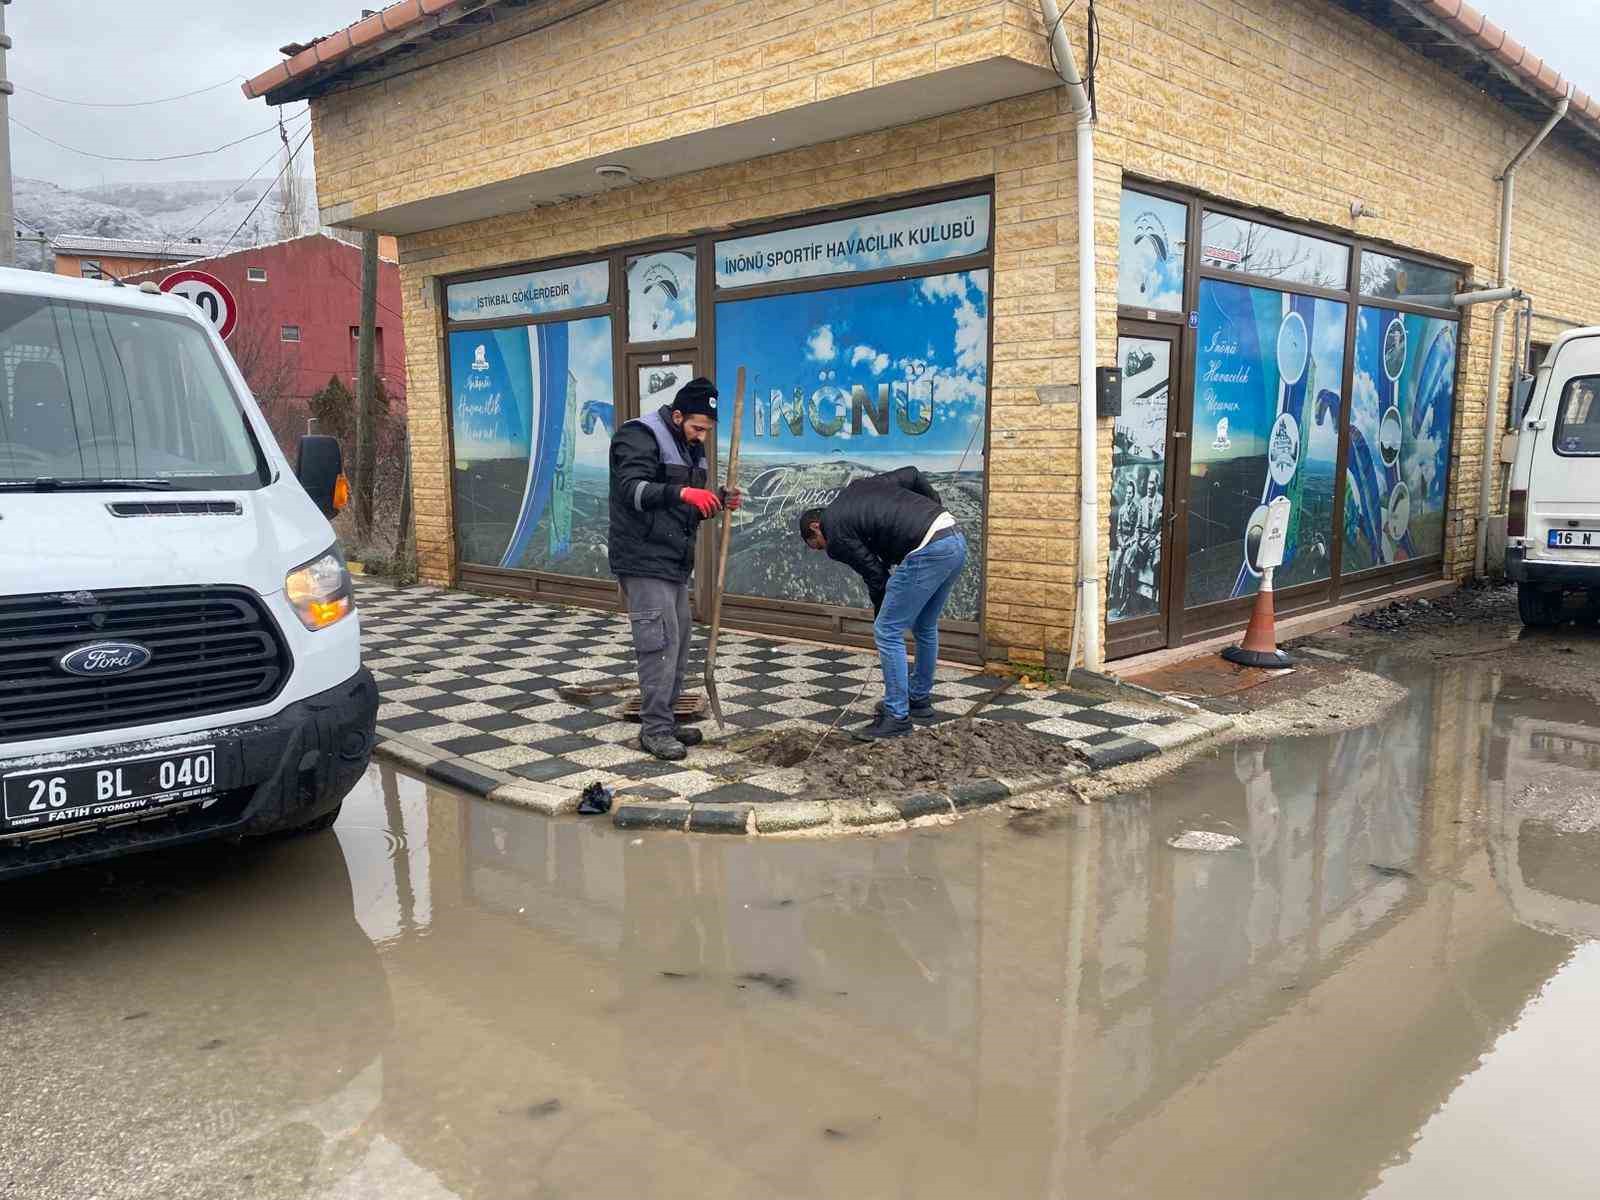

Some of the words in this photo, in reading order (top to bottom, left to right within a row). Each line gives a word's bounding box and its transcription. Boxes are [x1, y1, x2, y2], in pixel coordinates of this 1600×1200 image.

[725, 250, 764, 274] İNÖNÜ
[766, 242, 823, 267] SPORTİF
[826, 231, 904, 258] HAVACILIK
[908, 216, 975, 245] KULUBÜ
[173, 290, 219, 324] 0
[477, 293, 511, 309] İSTİKBAL
[753, 363, 935, 438] İNÖNÜ
[1557, 532, 1573, 545] 16
[83, 648, 133, 670] Ford
[28, 777, 67, 811] 26
[97, 768, 132, 800] BL
[159, 755, 210, 789] 040
